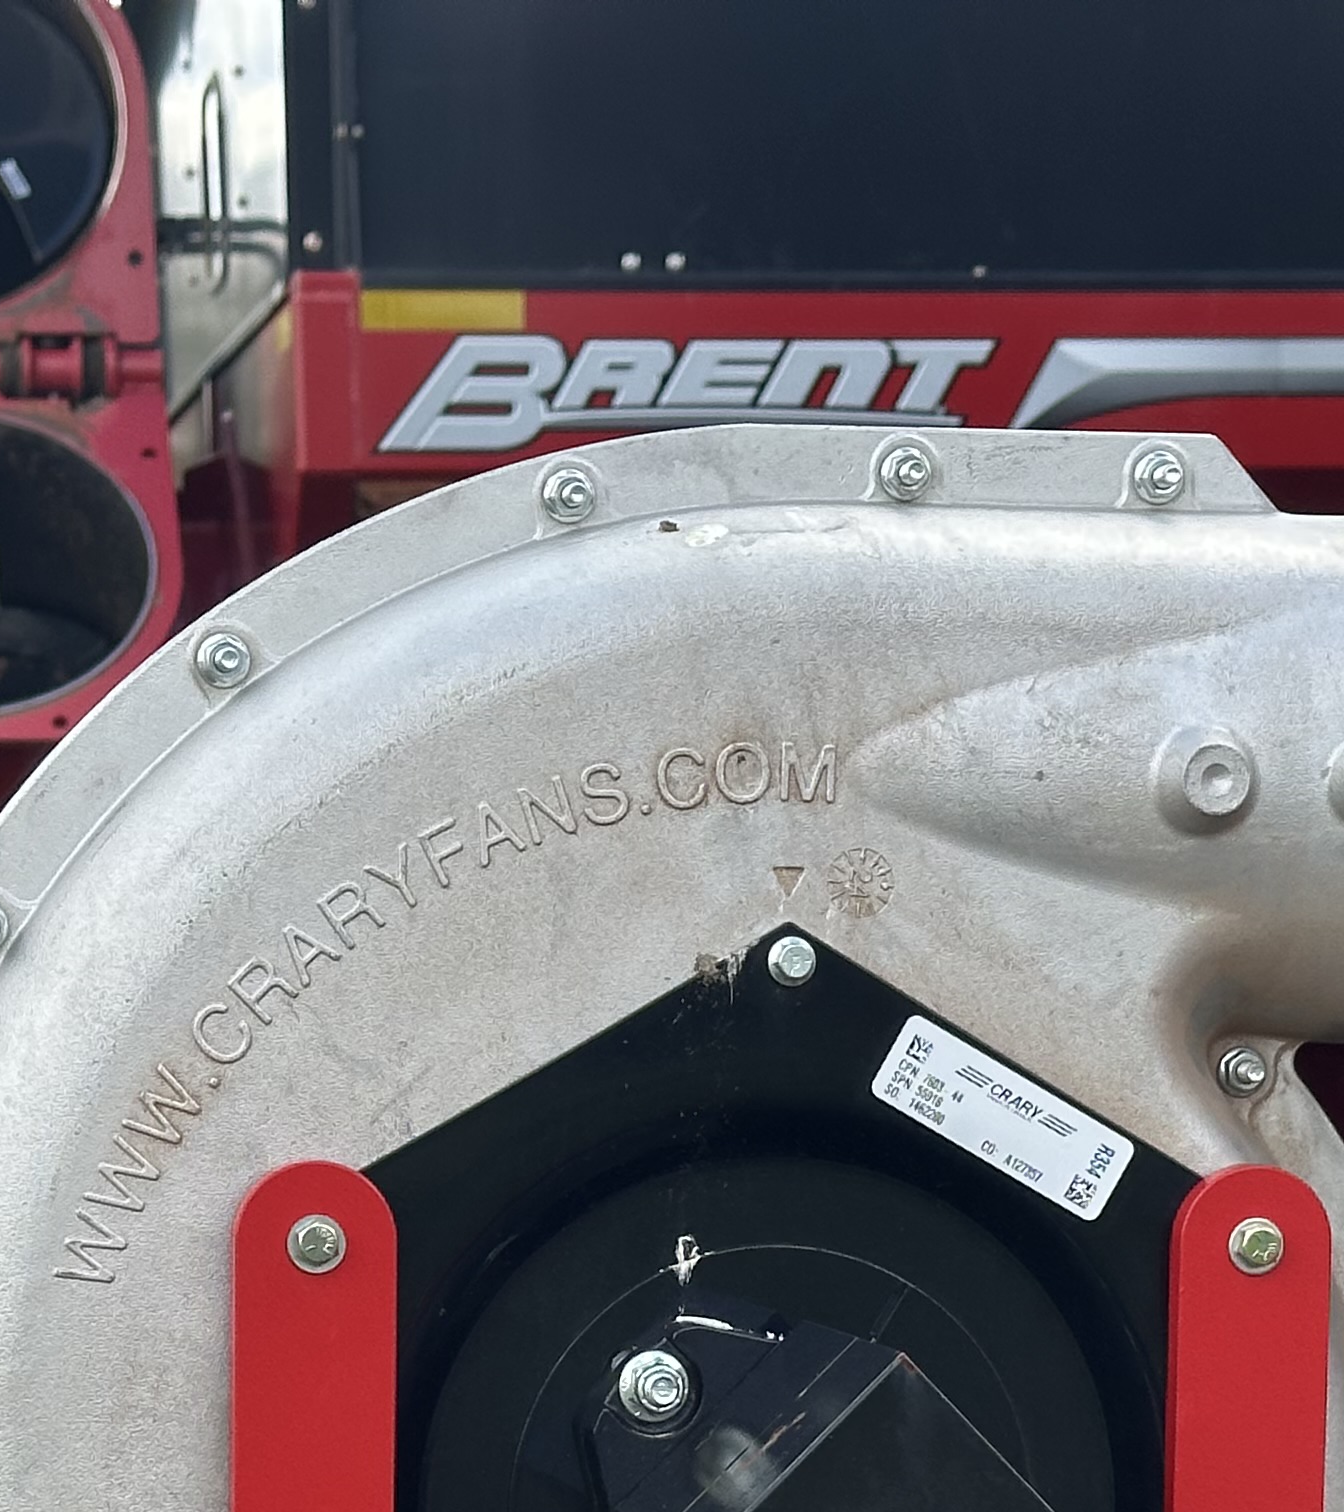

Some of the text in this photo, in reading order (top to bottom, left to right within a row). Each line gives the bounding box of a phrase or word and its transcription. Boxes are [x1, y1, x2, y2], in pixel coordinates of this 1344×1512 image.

[376, 334, 1001, 452] BRENT
[55, 741, 840, 1285] WWW.CRARYFANS.COM
[991, 1084, 1043, 1118] CRARY
